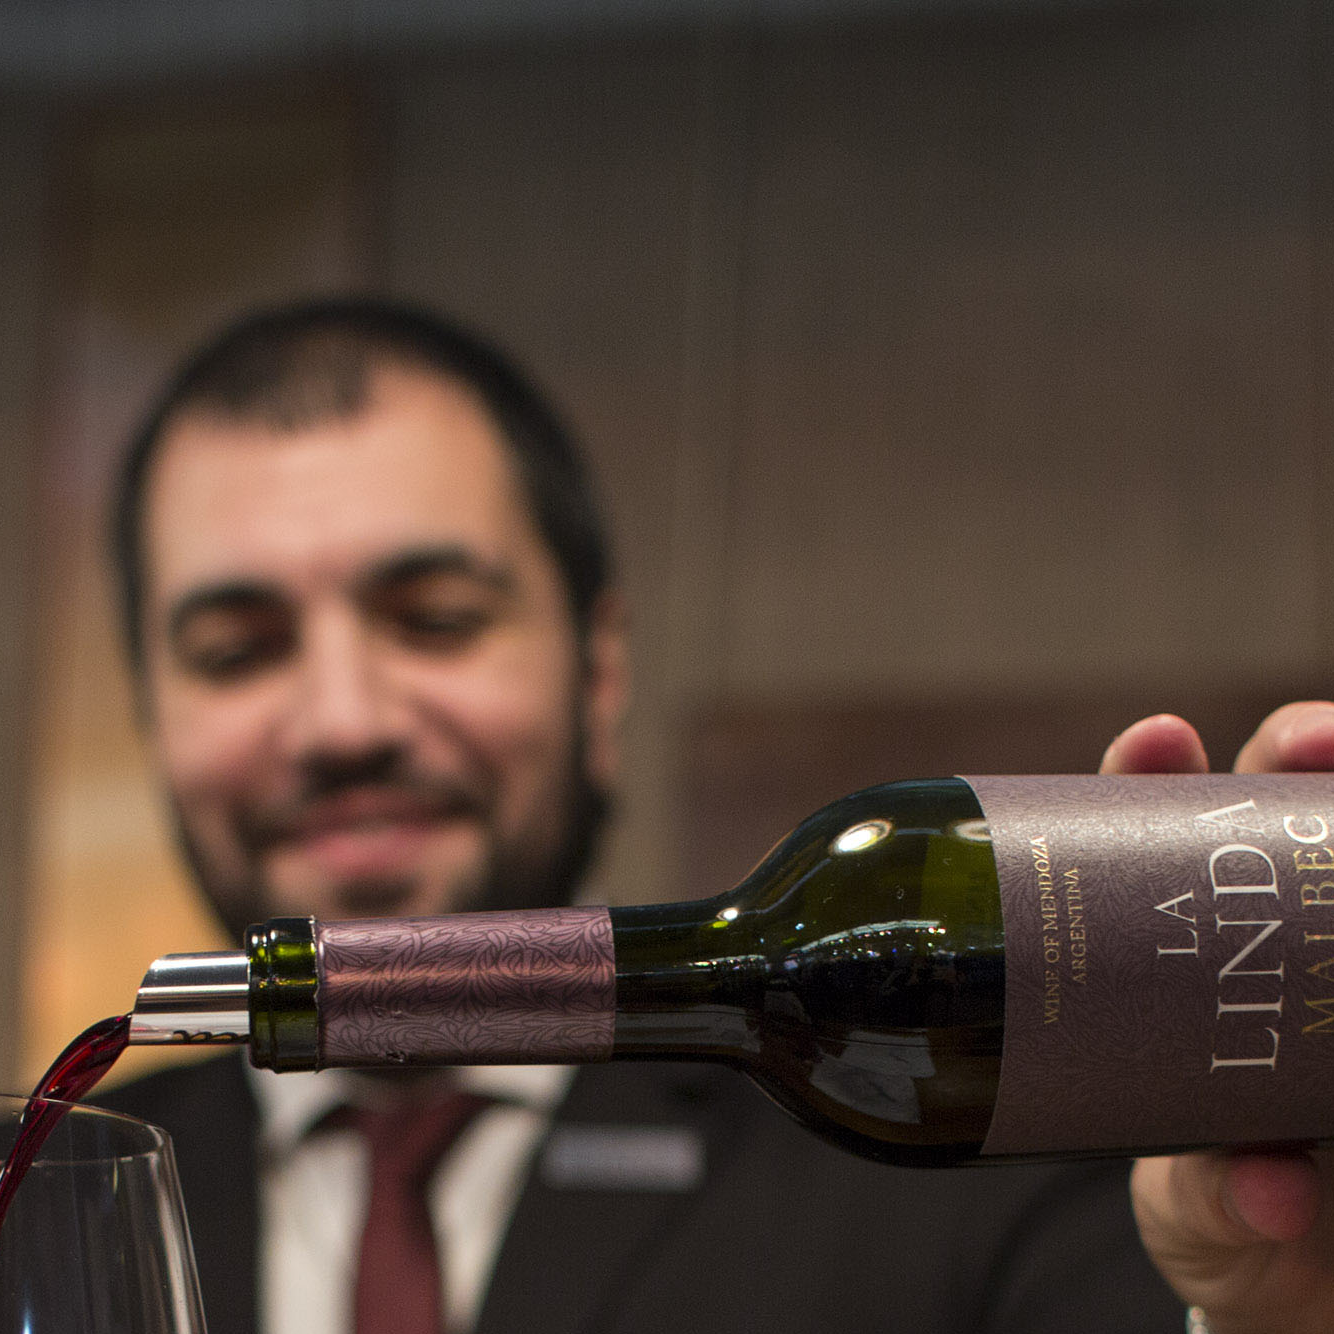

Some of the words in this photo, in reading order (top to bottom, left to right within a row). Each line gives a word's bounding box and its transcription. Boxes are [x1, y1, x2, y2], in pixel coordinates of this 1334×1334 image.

[1029, 834, 1060, 932] MENDOZA
[1153, 888, 1199, 959] LA
[1044, 935, 1061, 965] OF
[1063, 866, 1087, 985] ARGENTINA
[1194, 798, 1285, 1073] LINDA
[1043, 969, 1060, 1025] WINE
